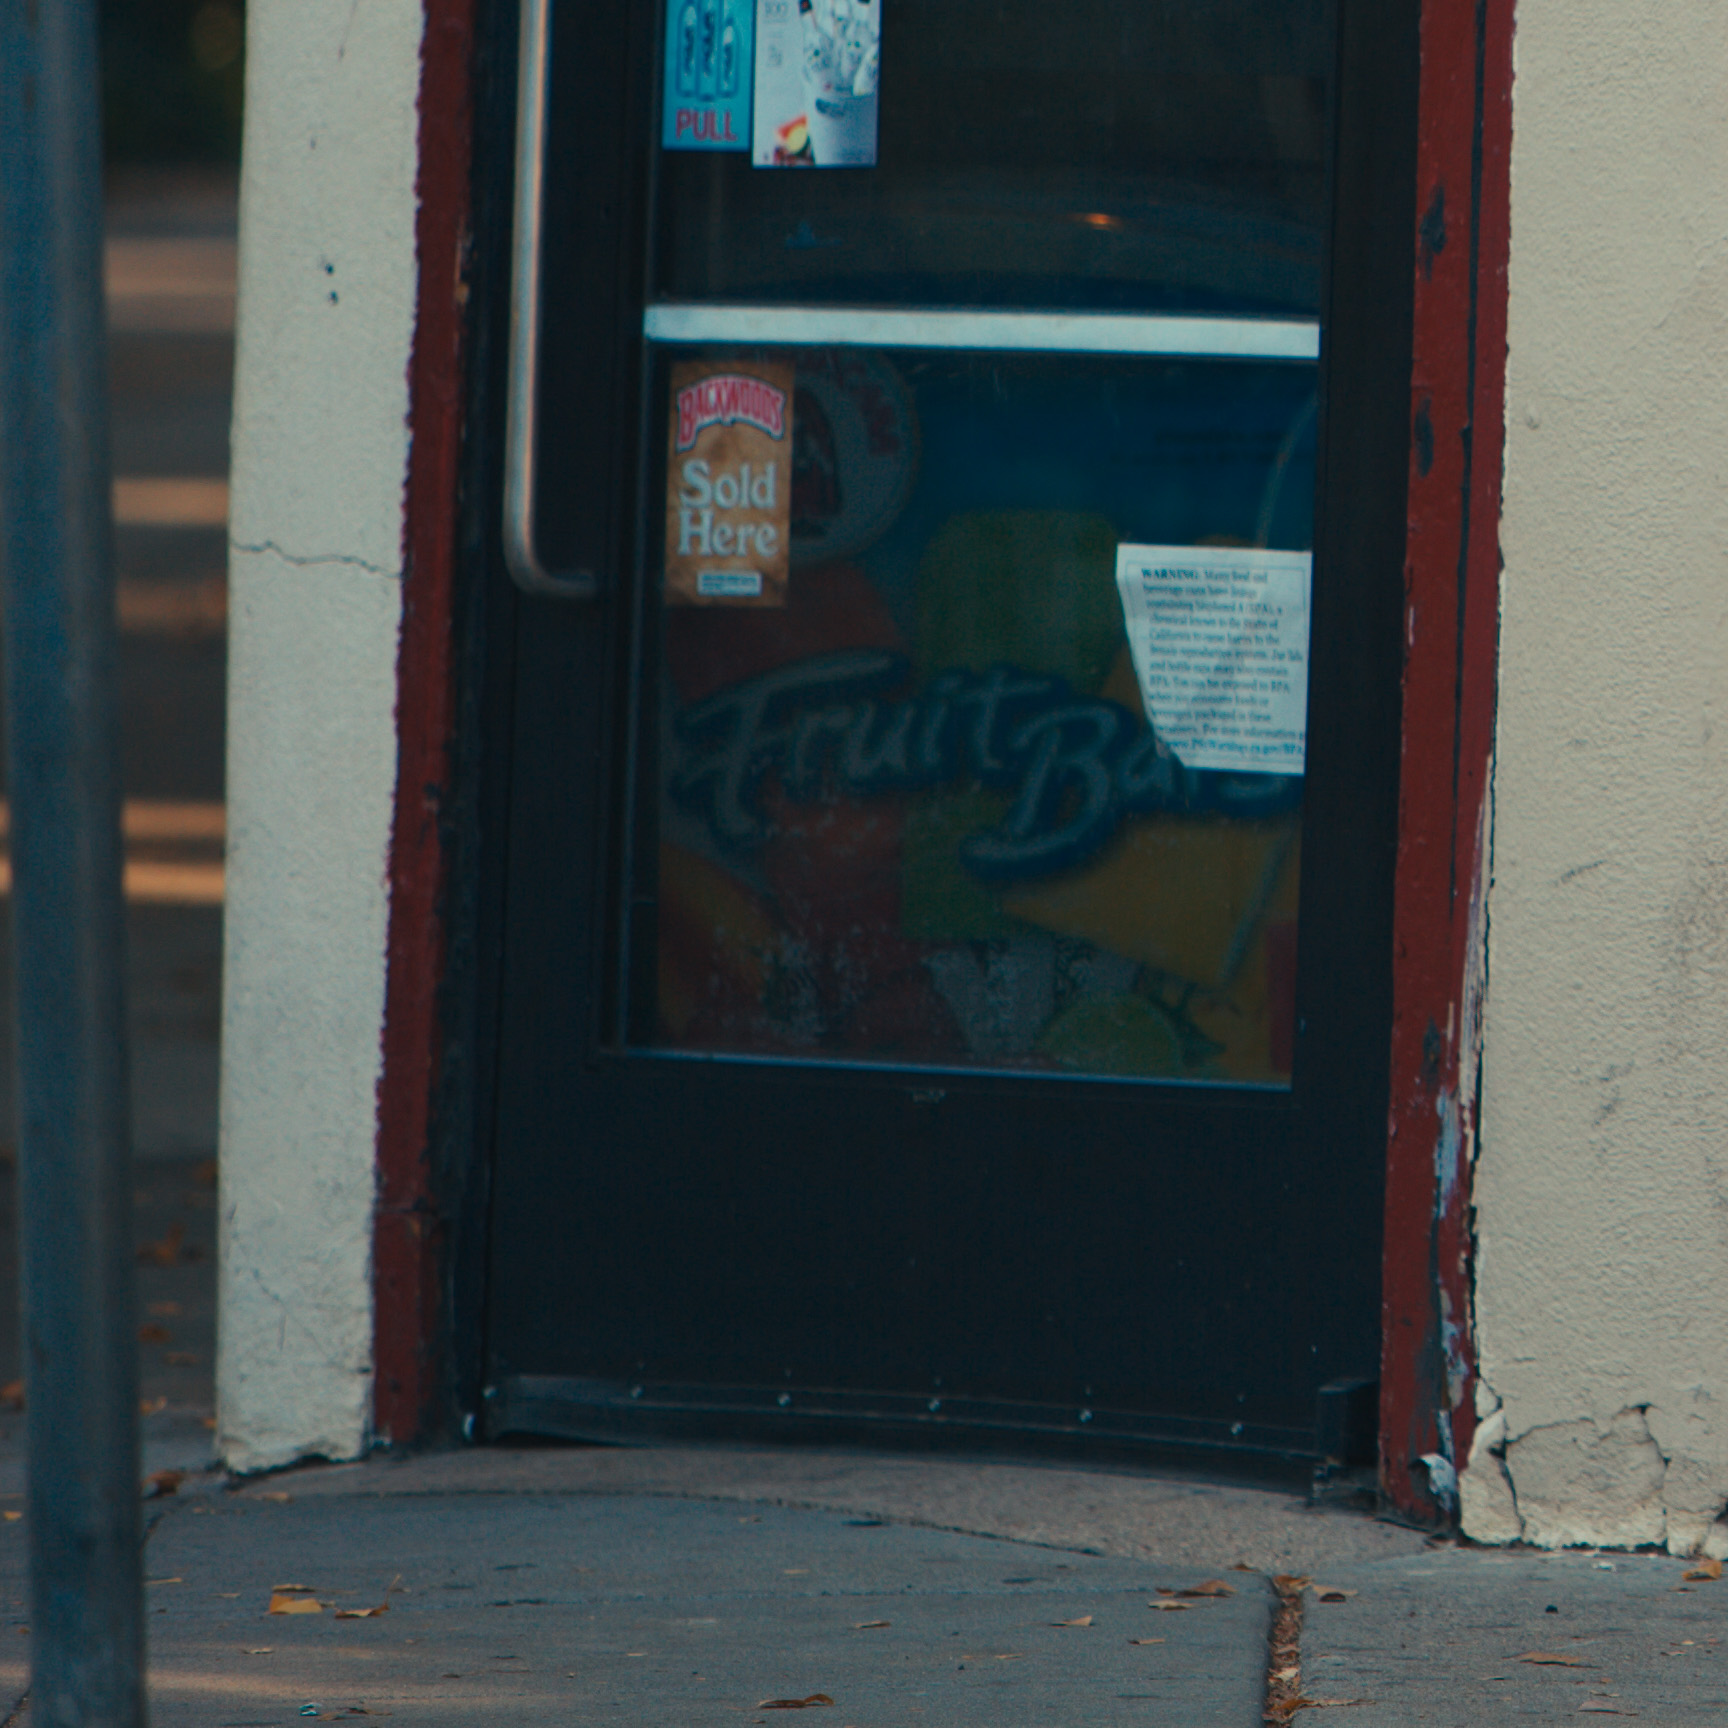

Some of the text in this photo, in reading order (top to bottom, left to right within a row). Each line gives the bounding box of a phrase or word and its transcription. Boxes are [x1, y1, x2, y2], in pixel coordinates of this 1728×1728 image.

[675, 109, 738, 142] PULL
[678, 374, 785, 450] BACKWOODS
[680, 459, 777, 509] Sold
[678, 510, 778, 558] Here
[684, 654, 1288, 865] Fruit Ba
